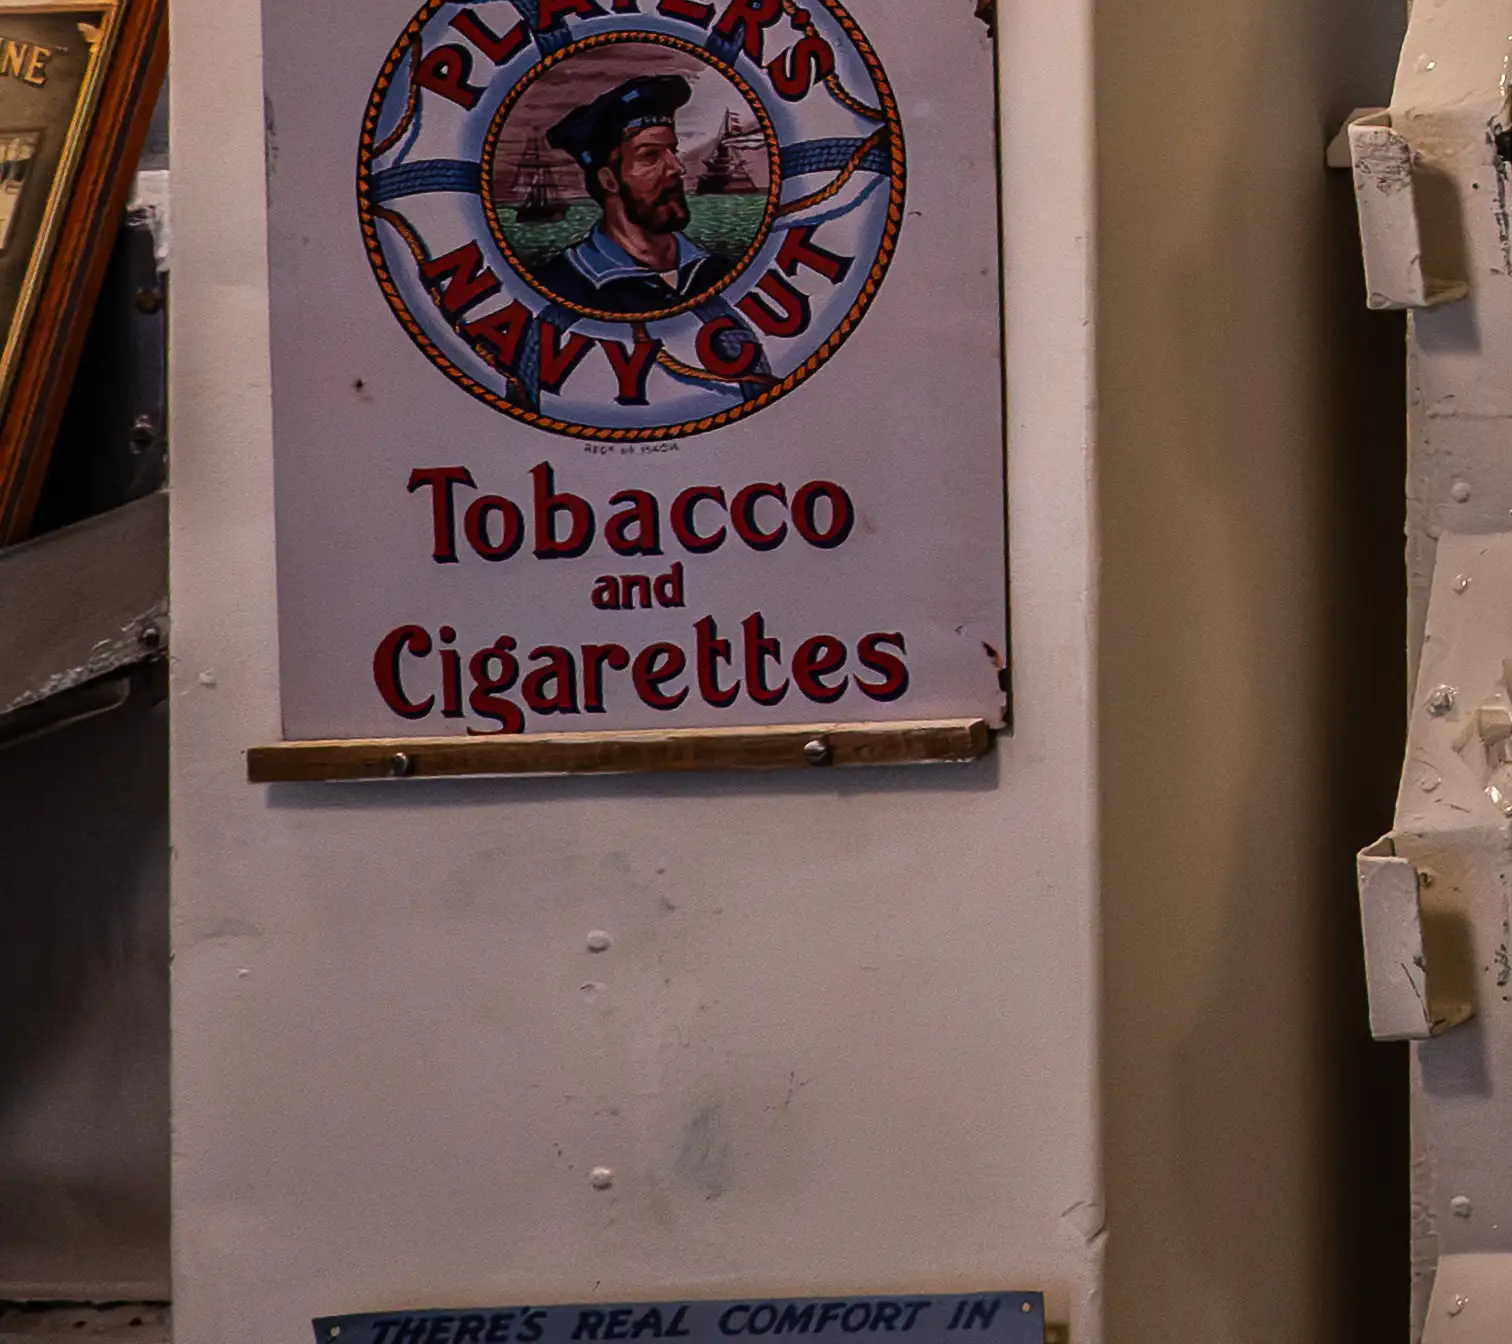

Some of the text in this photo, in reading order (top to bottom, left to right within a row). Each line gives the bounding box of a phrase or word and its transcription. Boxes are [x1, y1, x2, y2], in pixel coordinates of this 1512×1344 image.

[426, 226, 854, 405] NAVY CUT
[405, 460, 855, 566] Tobacco
[589, 562, 687, 612] and
[372, 610, 911, 736] Cigarettes
[371, 1300, 1001, 1344] THERE'S REAL COMFORT IN
